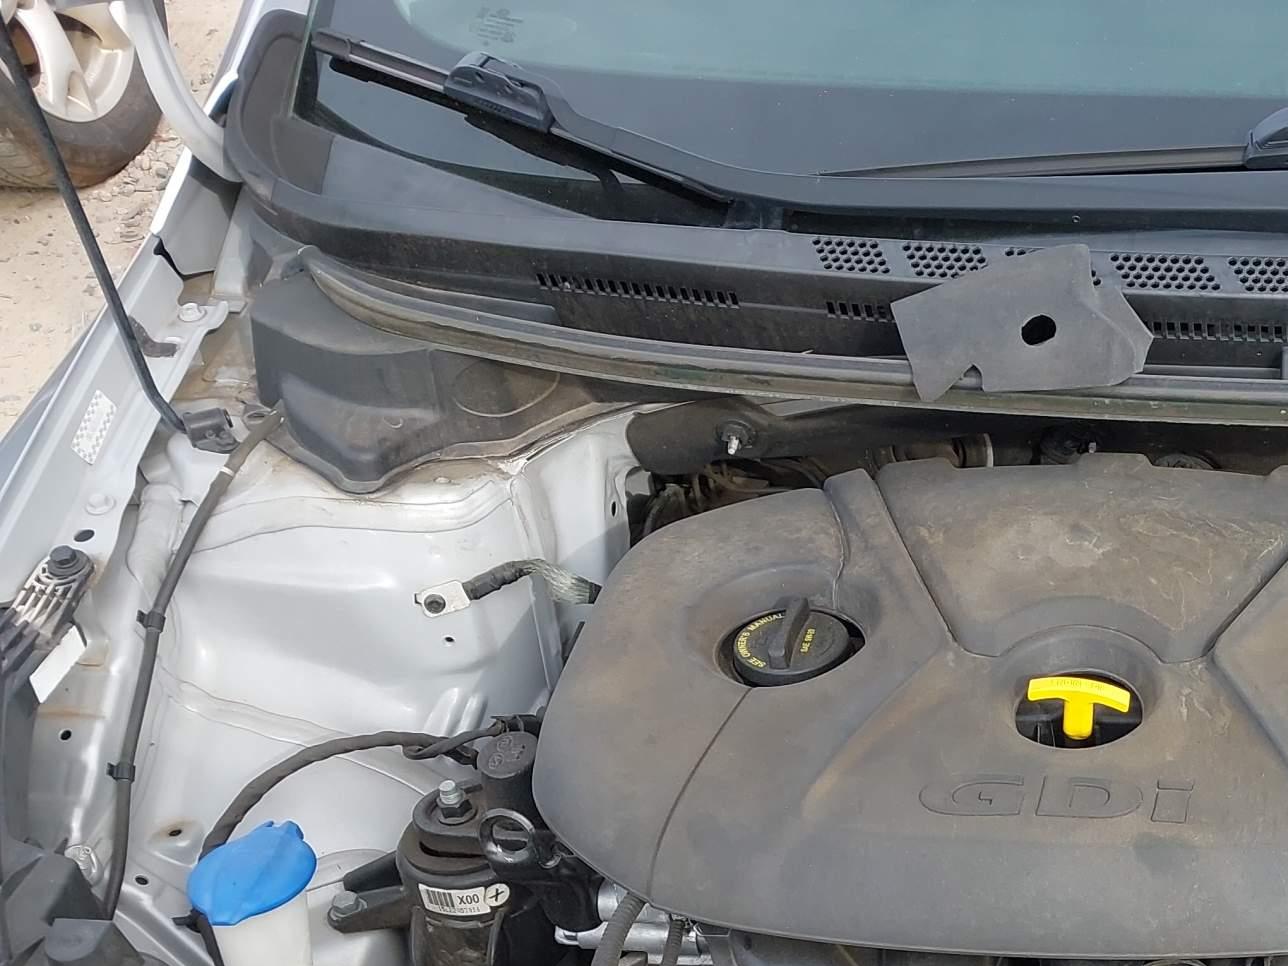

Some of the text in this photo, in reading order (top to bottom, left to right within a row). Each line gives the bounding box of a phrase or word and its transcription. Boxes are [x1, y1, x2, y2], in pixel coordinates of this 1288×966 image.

[737, 612, 784, 668] SEE OWNER'S MANUAL
[918, 776, 1195, 823] GDi
[457, 893, 480, 905] X00
